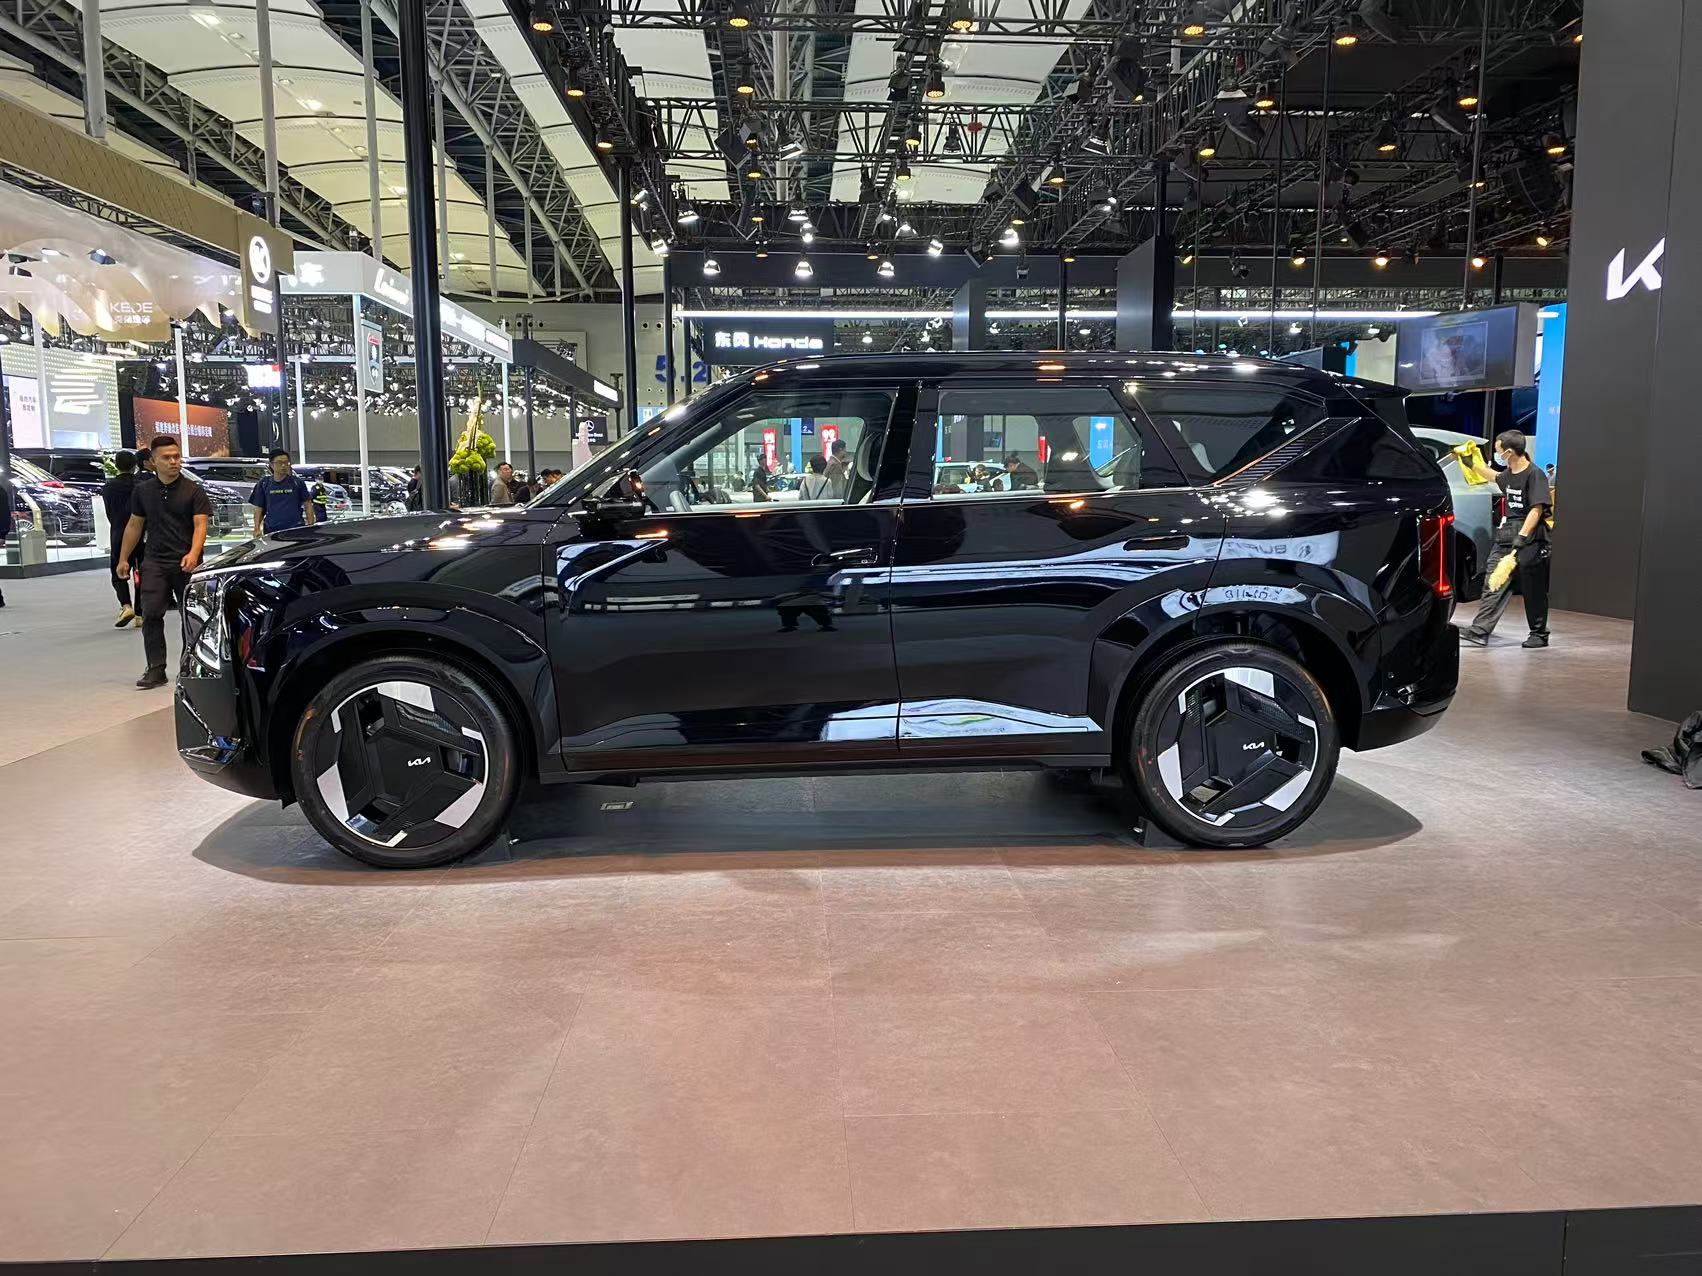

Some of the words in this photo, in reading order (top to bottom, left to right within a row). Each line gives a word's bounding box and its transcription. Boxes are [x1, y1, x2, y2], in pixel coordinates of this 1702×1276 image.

[753, 335, 824, 349] Honda
[1242, 741, 1265, 751] KIA
[407, 756, 431, 767] KIA
